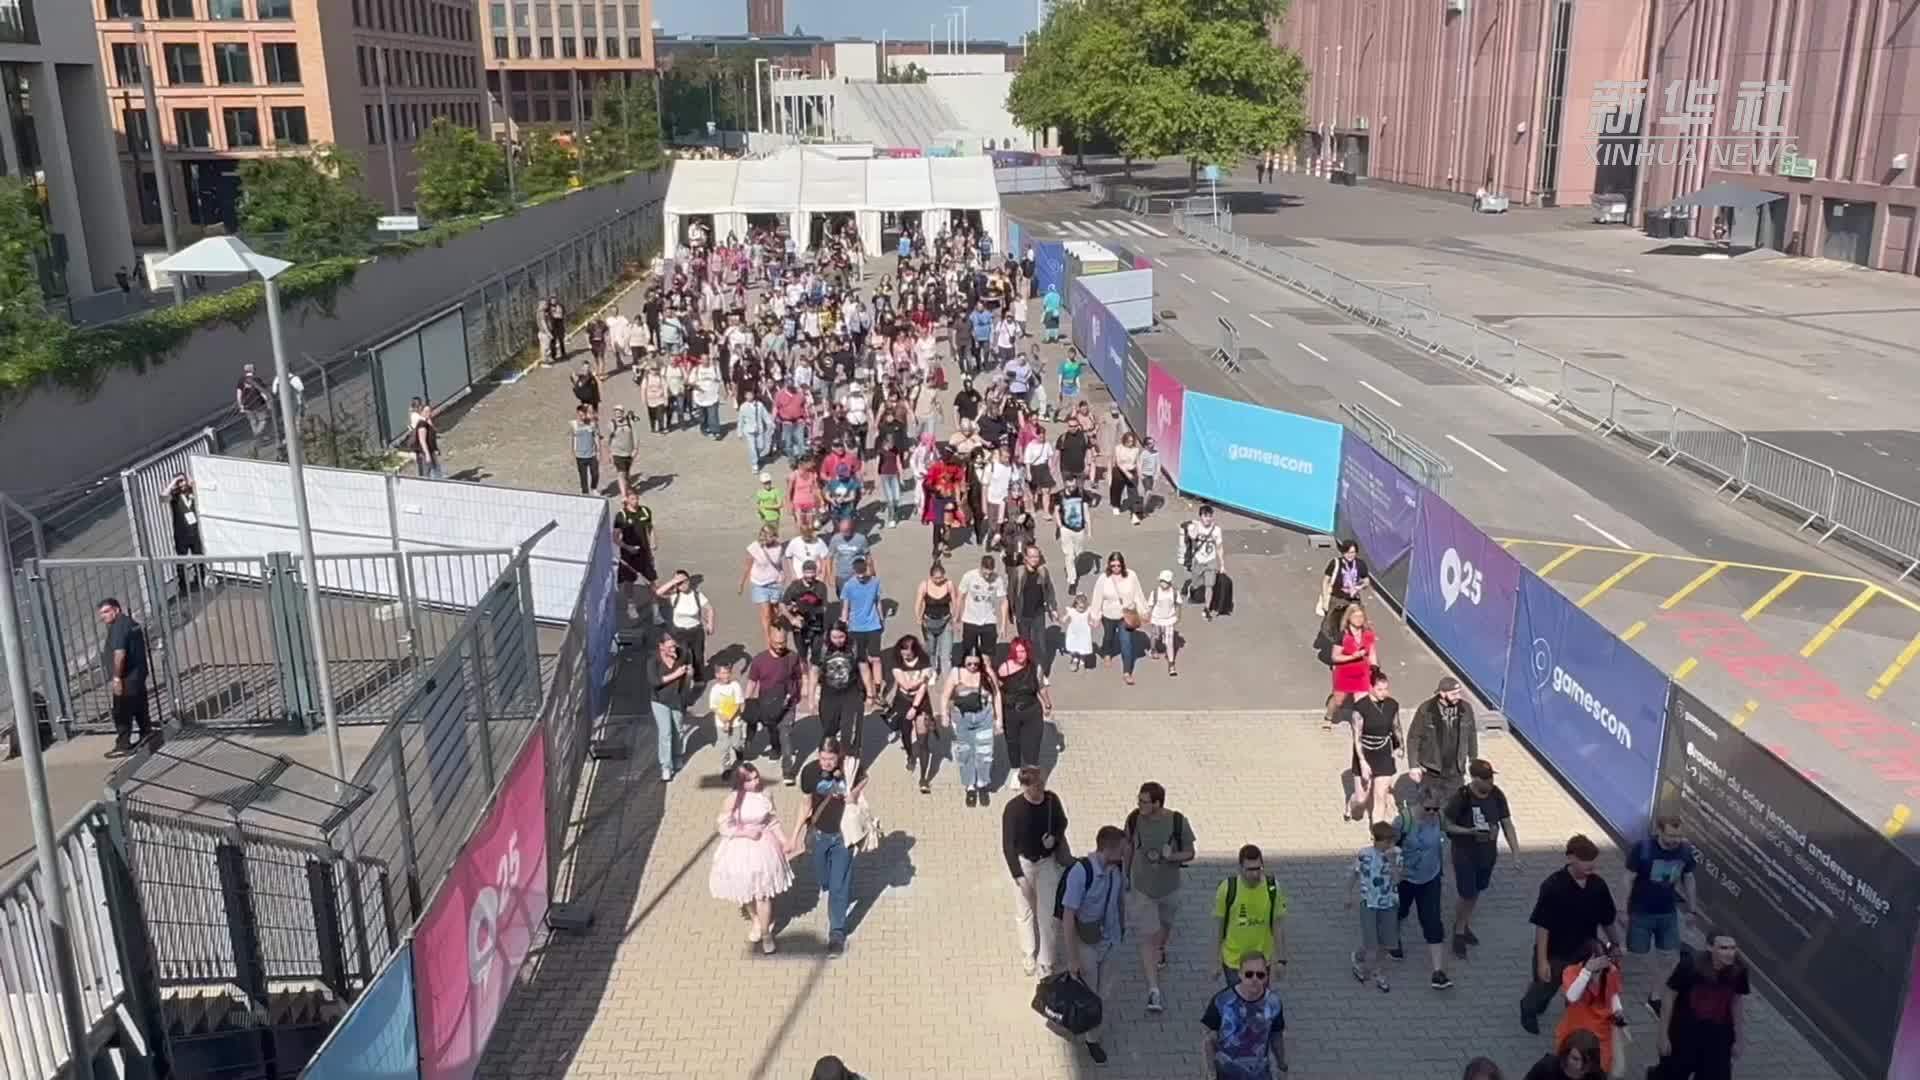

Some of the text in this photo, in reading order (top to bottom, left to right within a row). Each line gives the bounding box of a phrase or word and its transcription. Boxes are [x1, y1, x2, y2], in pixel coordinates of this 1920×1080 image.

[1228, 443, 1313, 475] gamescom
[1553, 666, 1632, 749] gamescom
[1808, 843, 1855, 886] anderes
